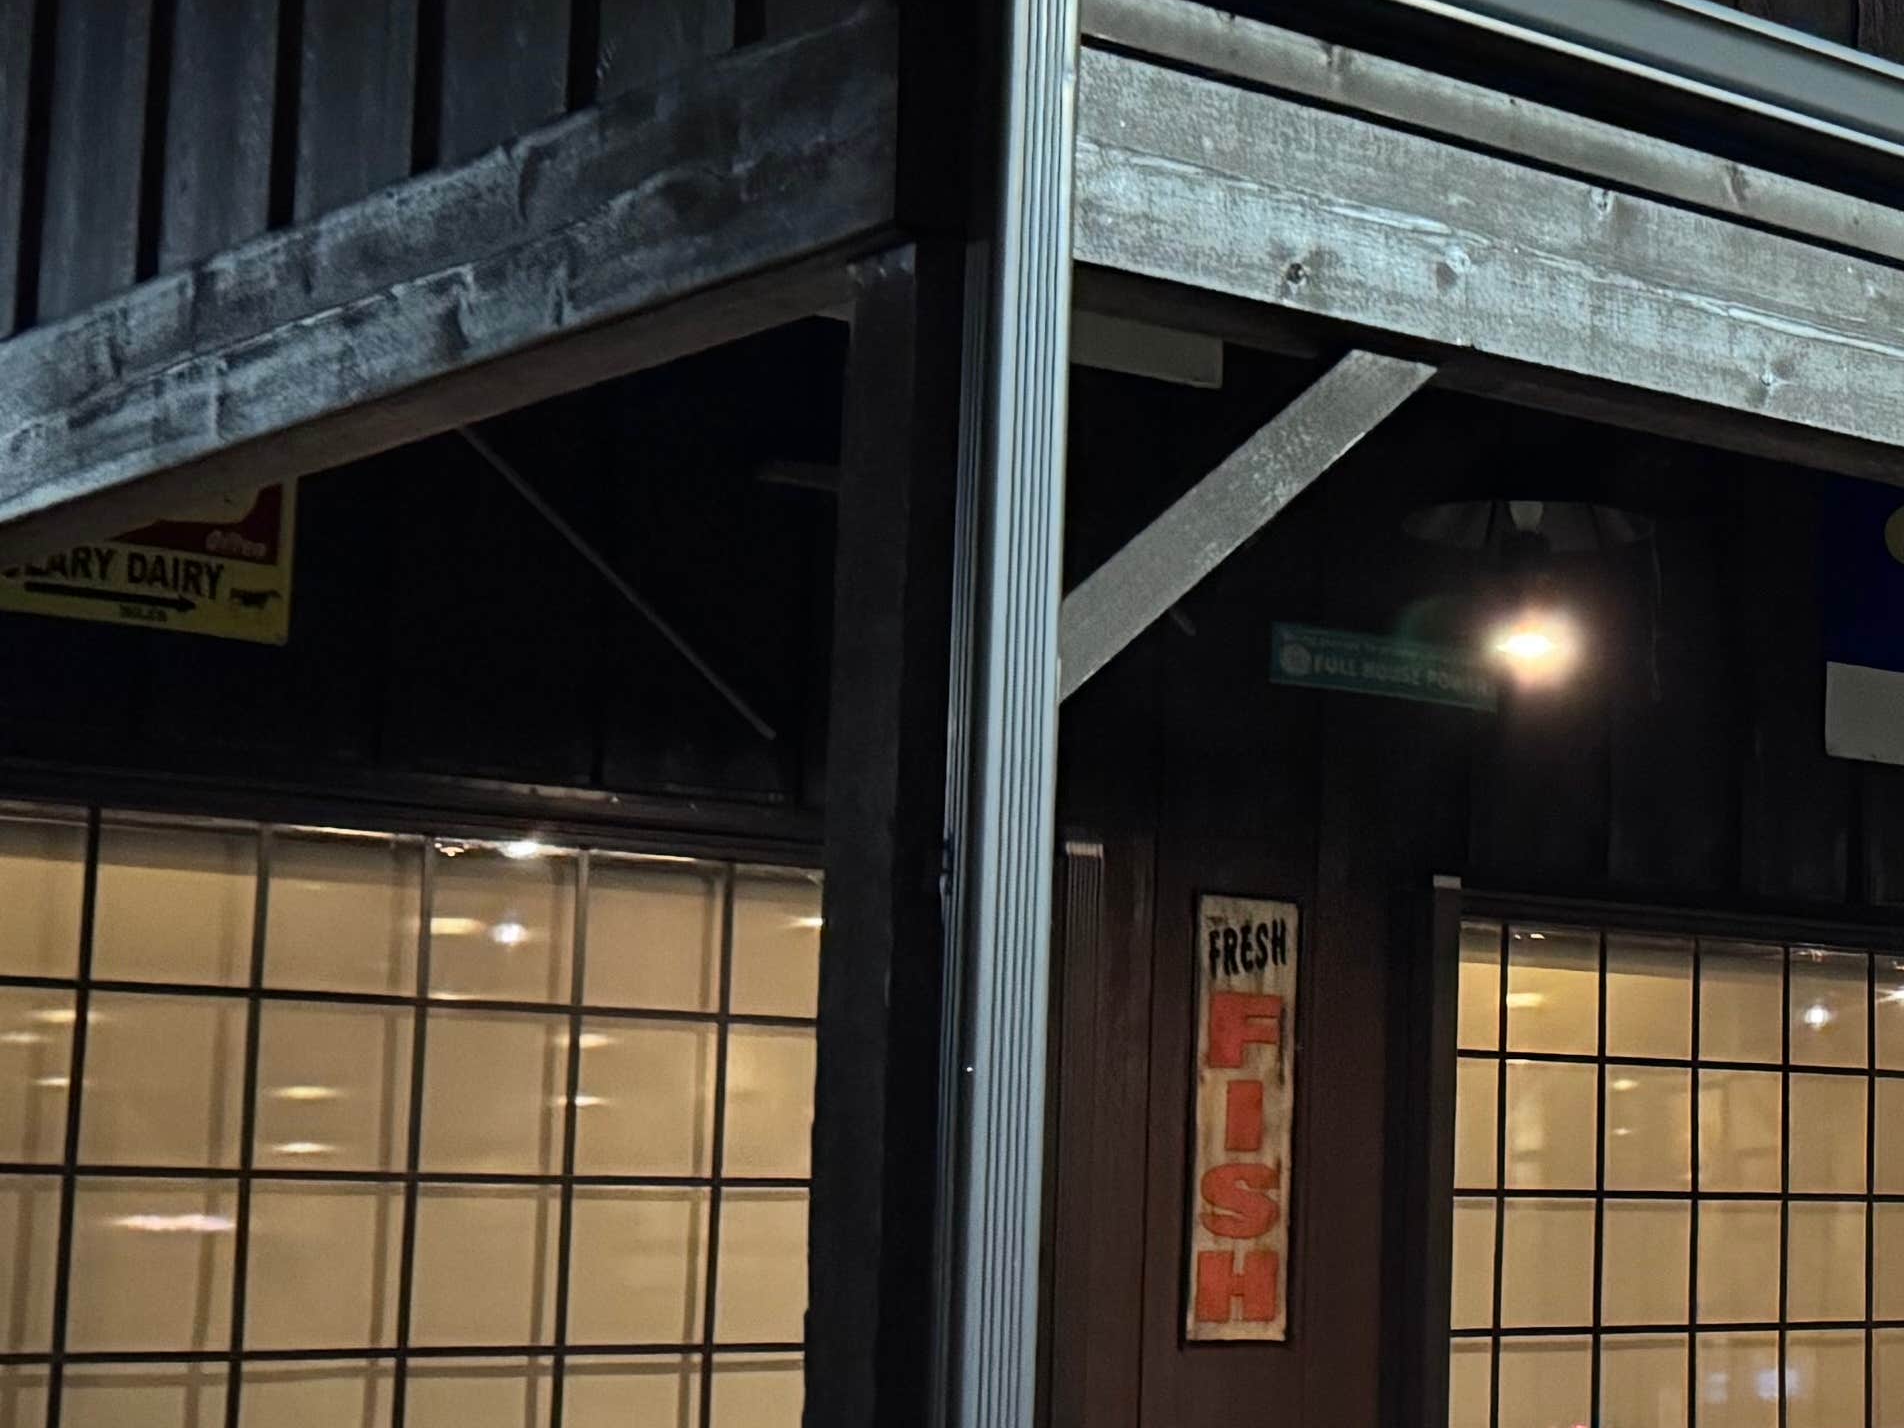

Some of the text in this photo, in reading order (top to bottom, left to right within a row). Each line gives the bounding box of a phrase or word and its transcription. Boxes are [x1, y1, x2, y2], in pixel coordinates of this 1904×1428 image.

[128, 551, 225, 601] DAIRY
[1208, 918, 1288, 976] FRESH
[1196, 991, 1284, 1322] FISH
